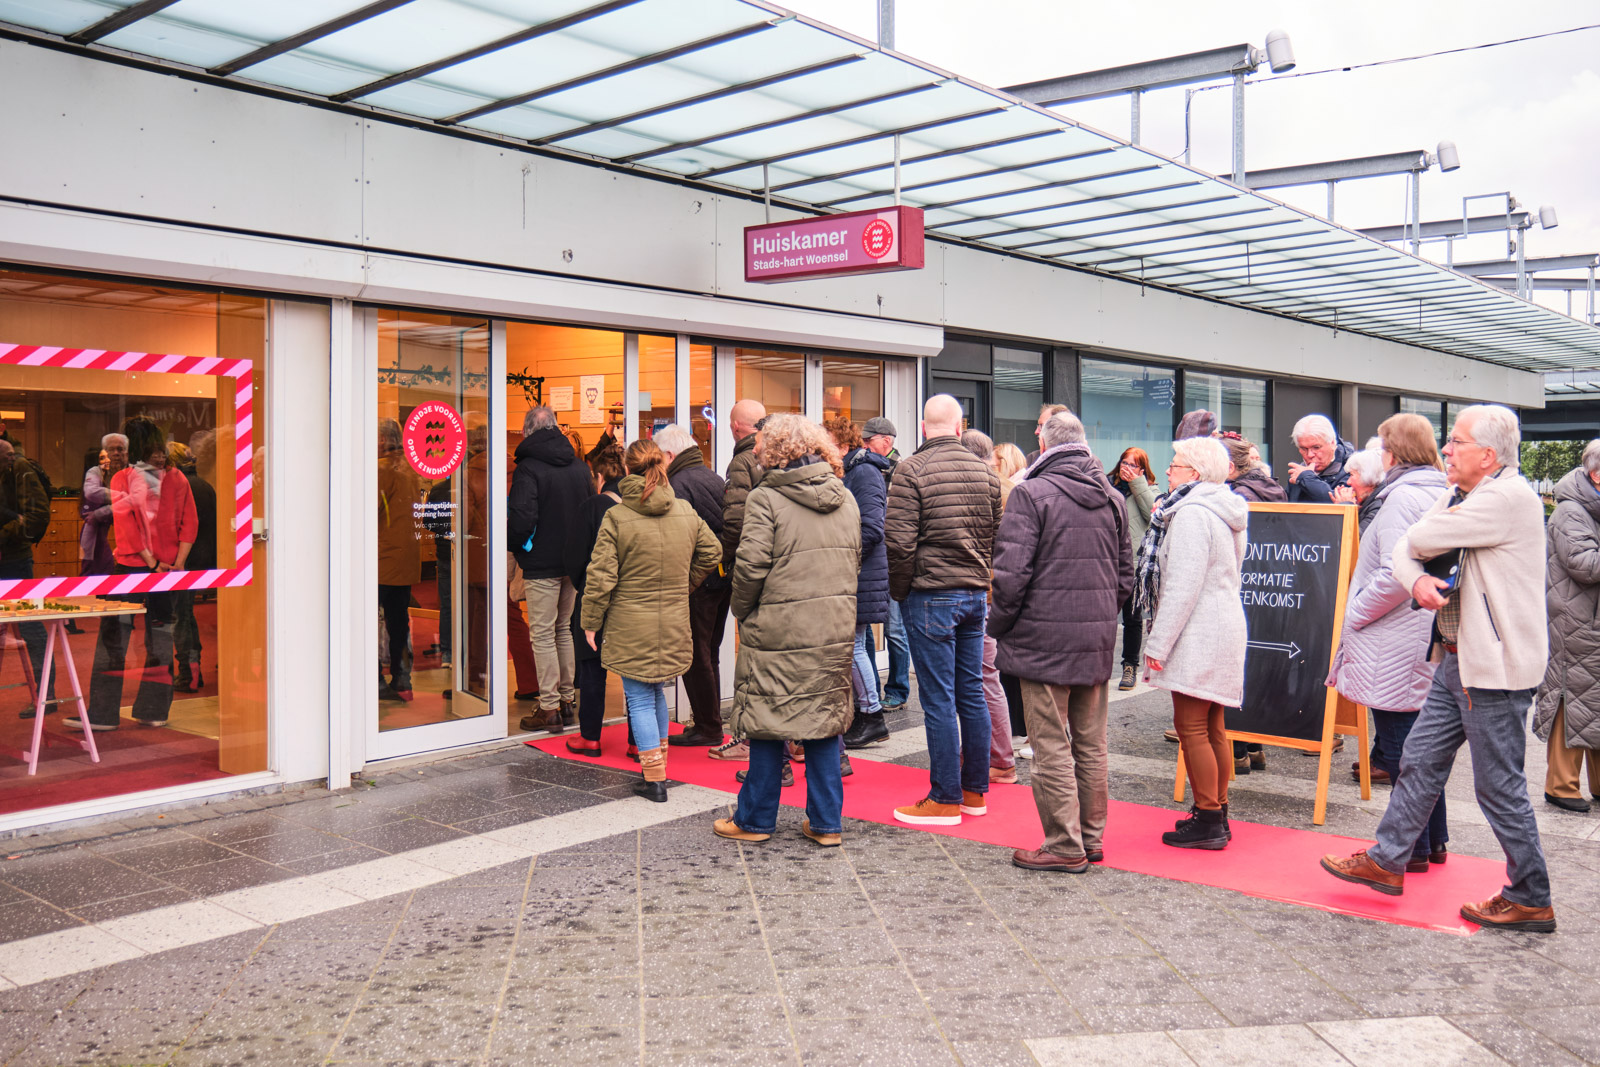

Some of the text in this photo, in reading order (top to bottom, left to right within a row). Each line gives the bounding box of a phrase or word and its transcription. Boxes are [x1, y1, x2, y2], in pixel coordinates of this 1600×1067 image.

[753, 230, 848, 255] Huiskamer
[753, 249, 849, 271] Stads-hart Woensel
[408, 404, 462, 433] EINDJE VOORUIT
[407, 438, 463, 475] OPEN EINDHOVEN.NL
[413, 501, 459, 511] Openingstijden:
[413, 511, 437, 519] Opening
